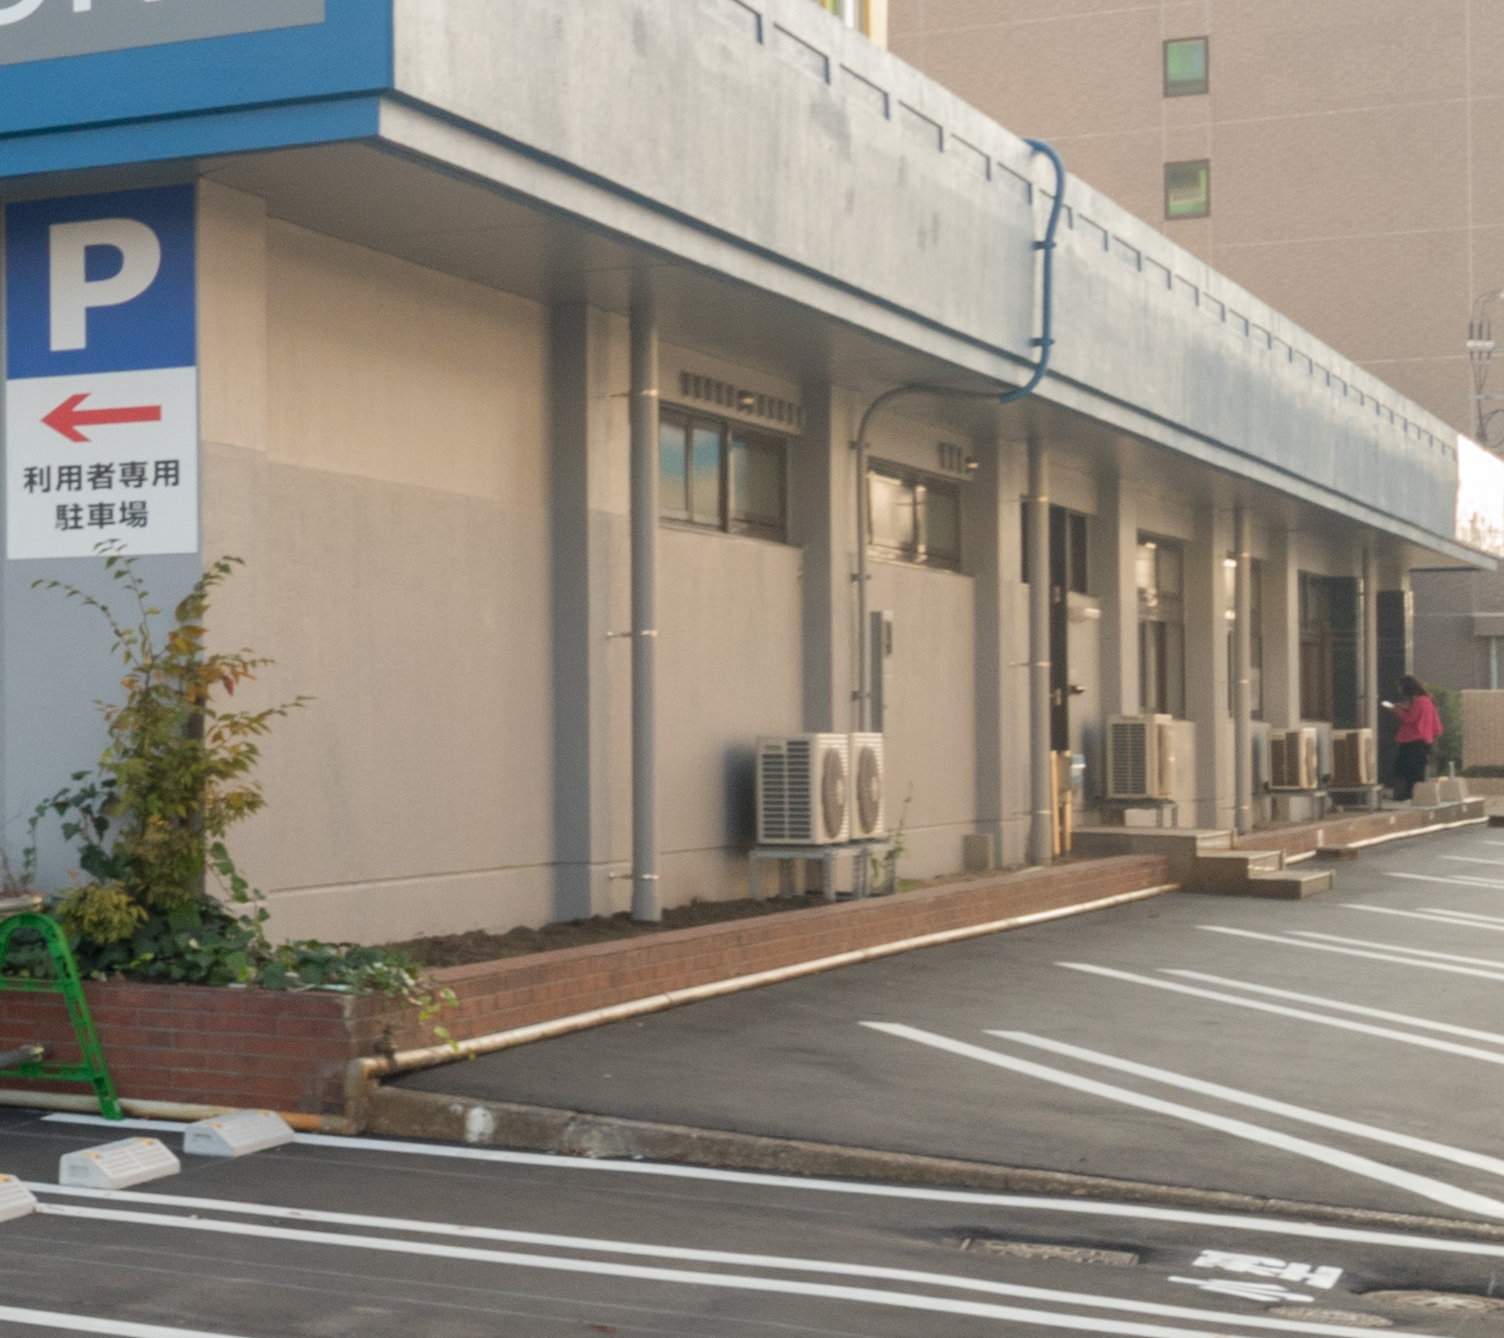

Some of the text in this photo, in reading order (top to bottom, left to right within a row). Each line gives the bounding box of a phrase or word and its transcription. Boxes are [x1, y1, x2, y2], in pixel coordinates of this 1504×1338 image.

[48, 217, 162, 352] P
[23, 459, 180, 493] 利用者専用
[55, 500, 148, 530] 駐車場
